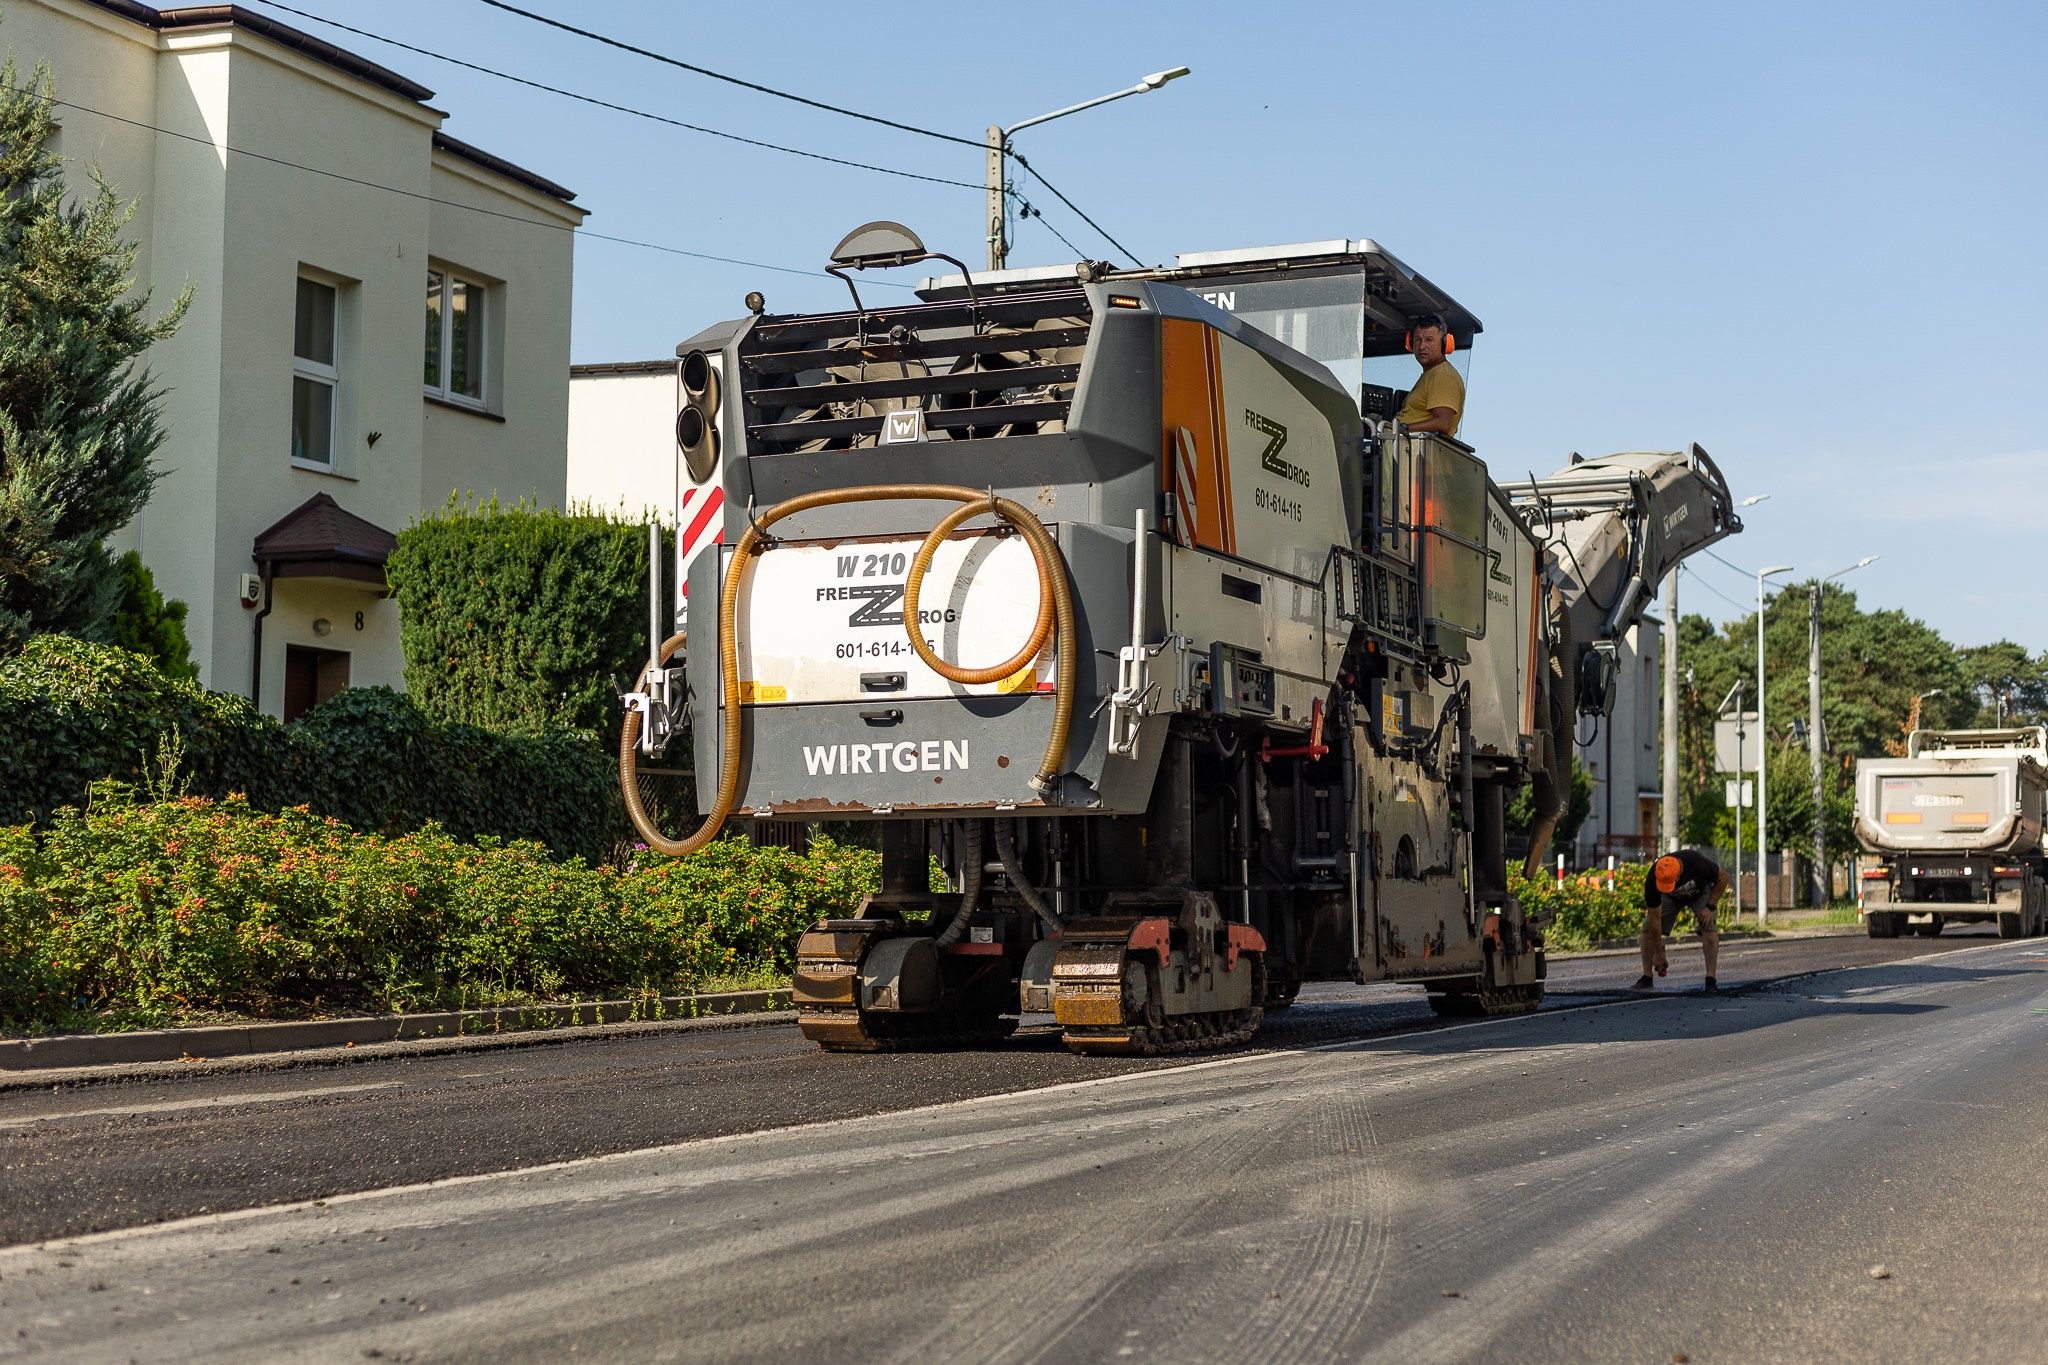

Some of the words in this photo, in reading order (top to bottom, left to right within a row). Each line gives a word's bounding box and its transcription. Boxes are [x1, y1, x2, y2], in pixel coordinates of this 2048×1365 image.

[1255, 487, 1302, 522] 601-614-115
[1493, 513, 1502, 536] 210
[837, 556, 859, 578] W
[862, 553, 906, 577] 210
[355, 611, 364, 631] 8
[836, 640, 935, 658] 601-614-15
[802, 739, 969, 776] WIRTGEN
